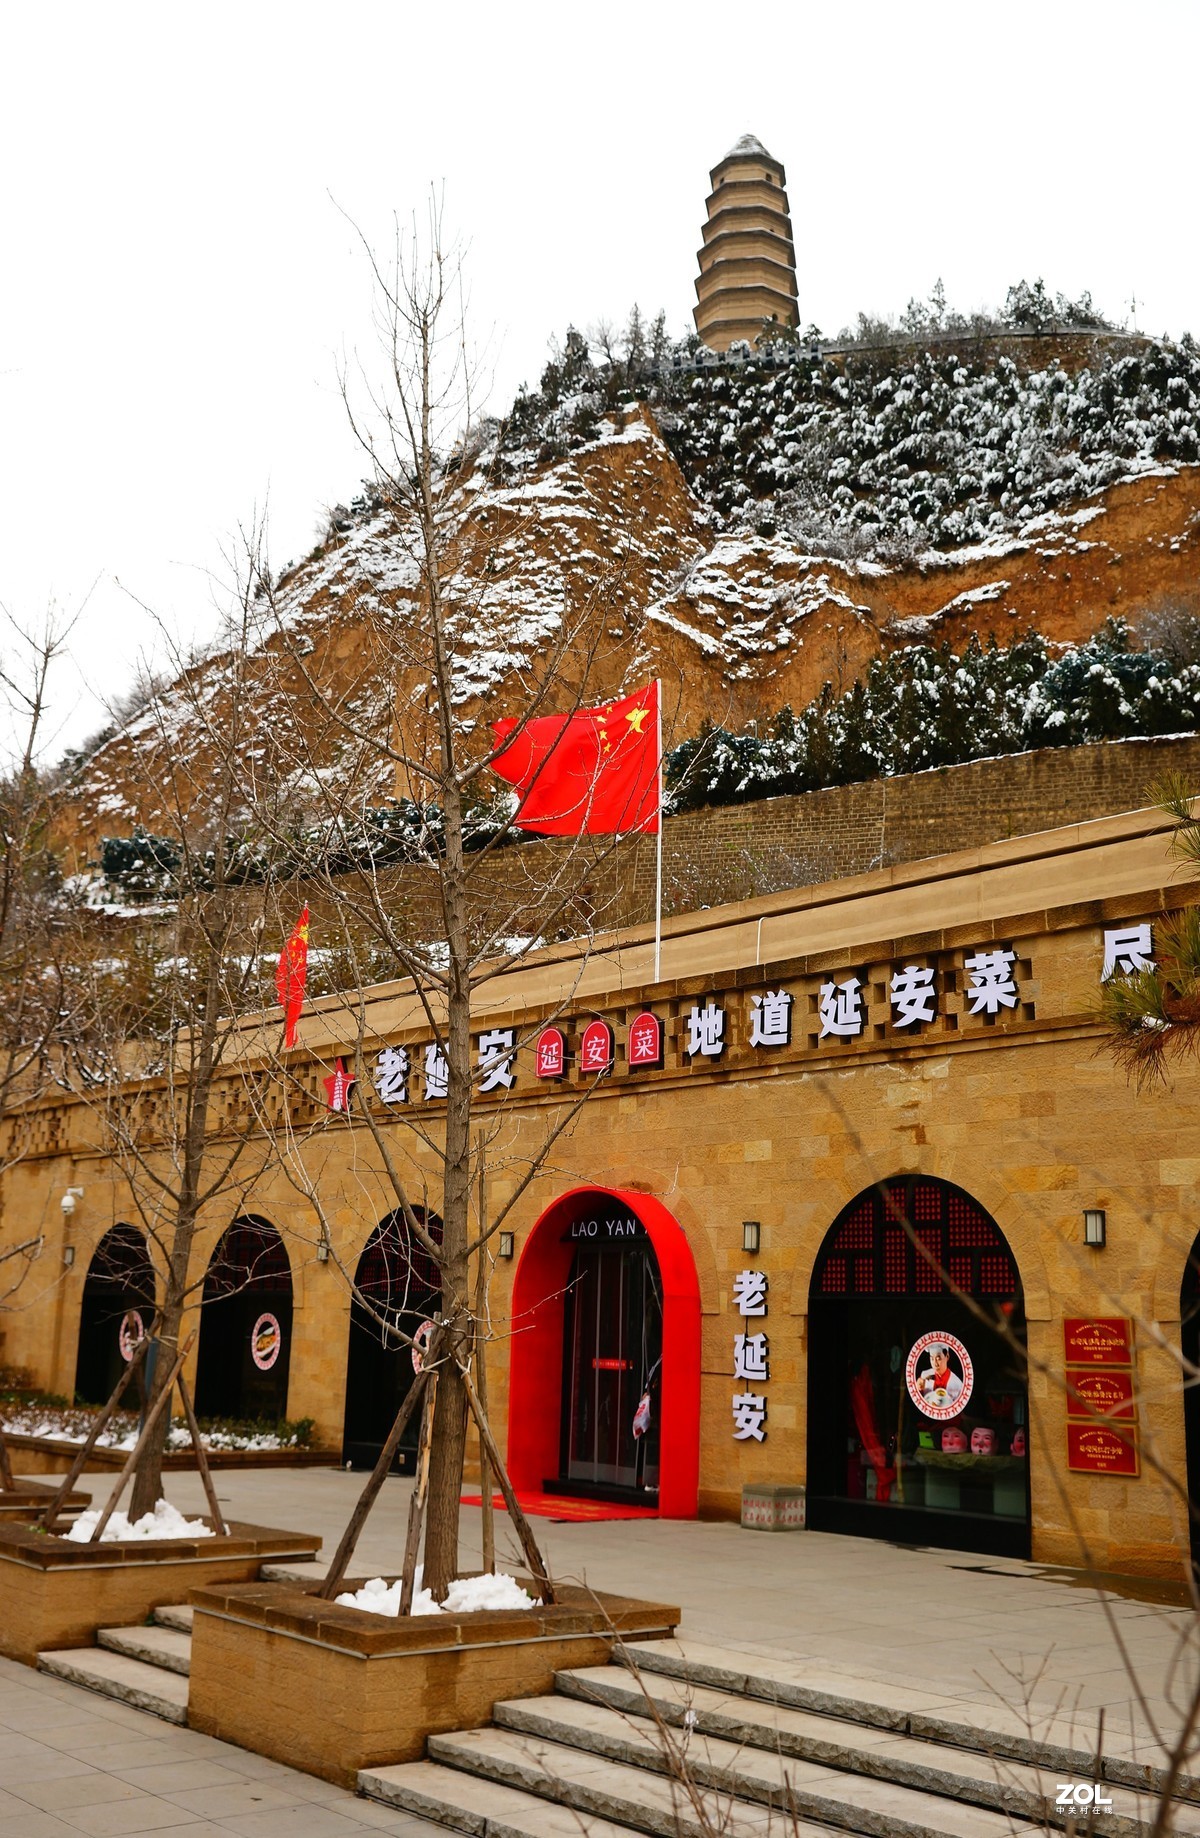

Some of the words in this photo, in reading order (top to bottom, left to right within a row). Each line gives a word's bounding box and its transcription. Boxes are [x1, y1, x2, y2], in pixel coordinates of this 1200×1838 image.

[687, 949, 1019, 1057] 地道延安菜
[540, 1028, 655, 1071] 延安菜
[571, 1220, 598, 1237] LAO
[605, 1219, 636, 1236] YAN
[732, 1269, 767, 1442] 老延安
